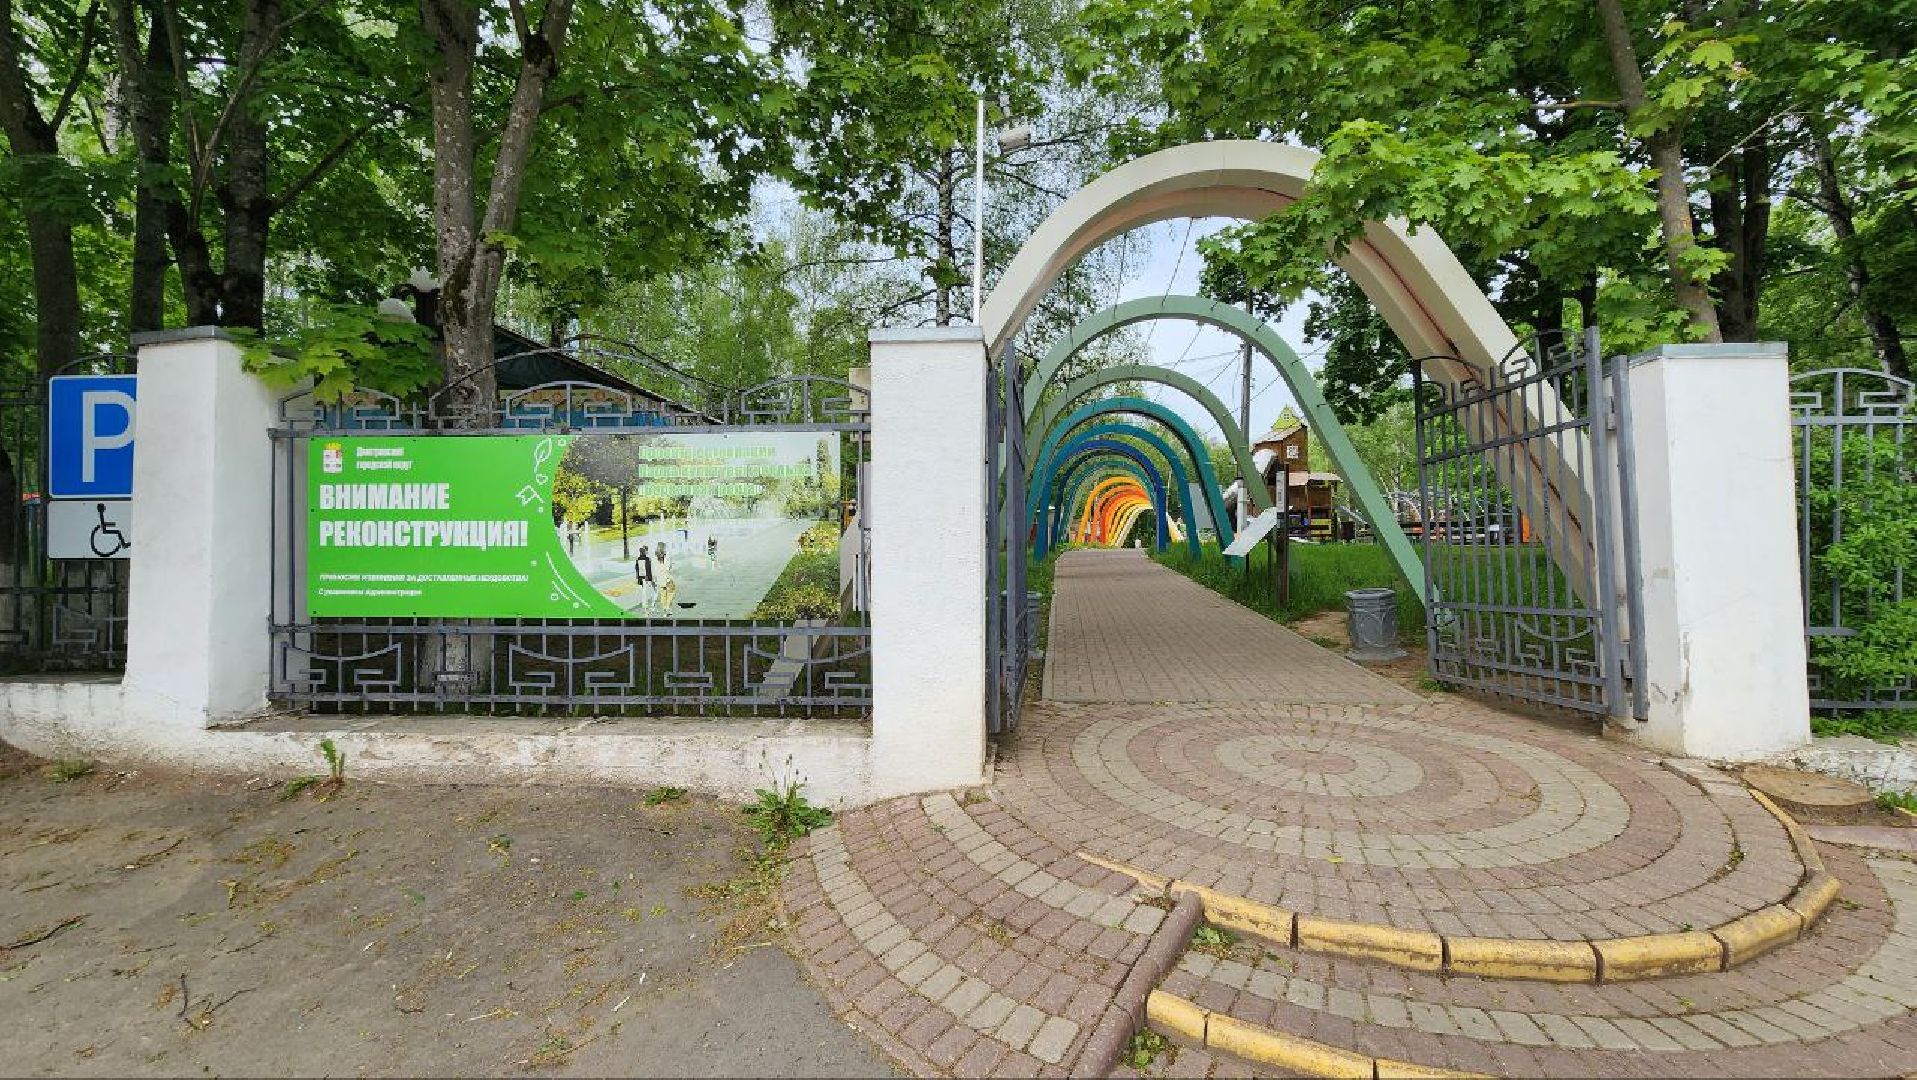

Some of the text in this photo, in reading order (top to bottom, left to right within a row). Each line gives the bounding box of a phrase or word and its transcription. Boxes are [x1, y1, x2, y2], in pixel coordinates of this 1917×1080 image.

[82, 390, 136, 483] P
[319, 483, 450, 510] ВНИМАНИЕ
[319, 520, 528, 552] РЕКОНСТРУКЦИЯ!
